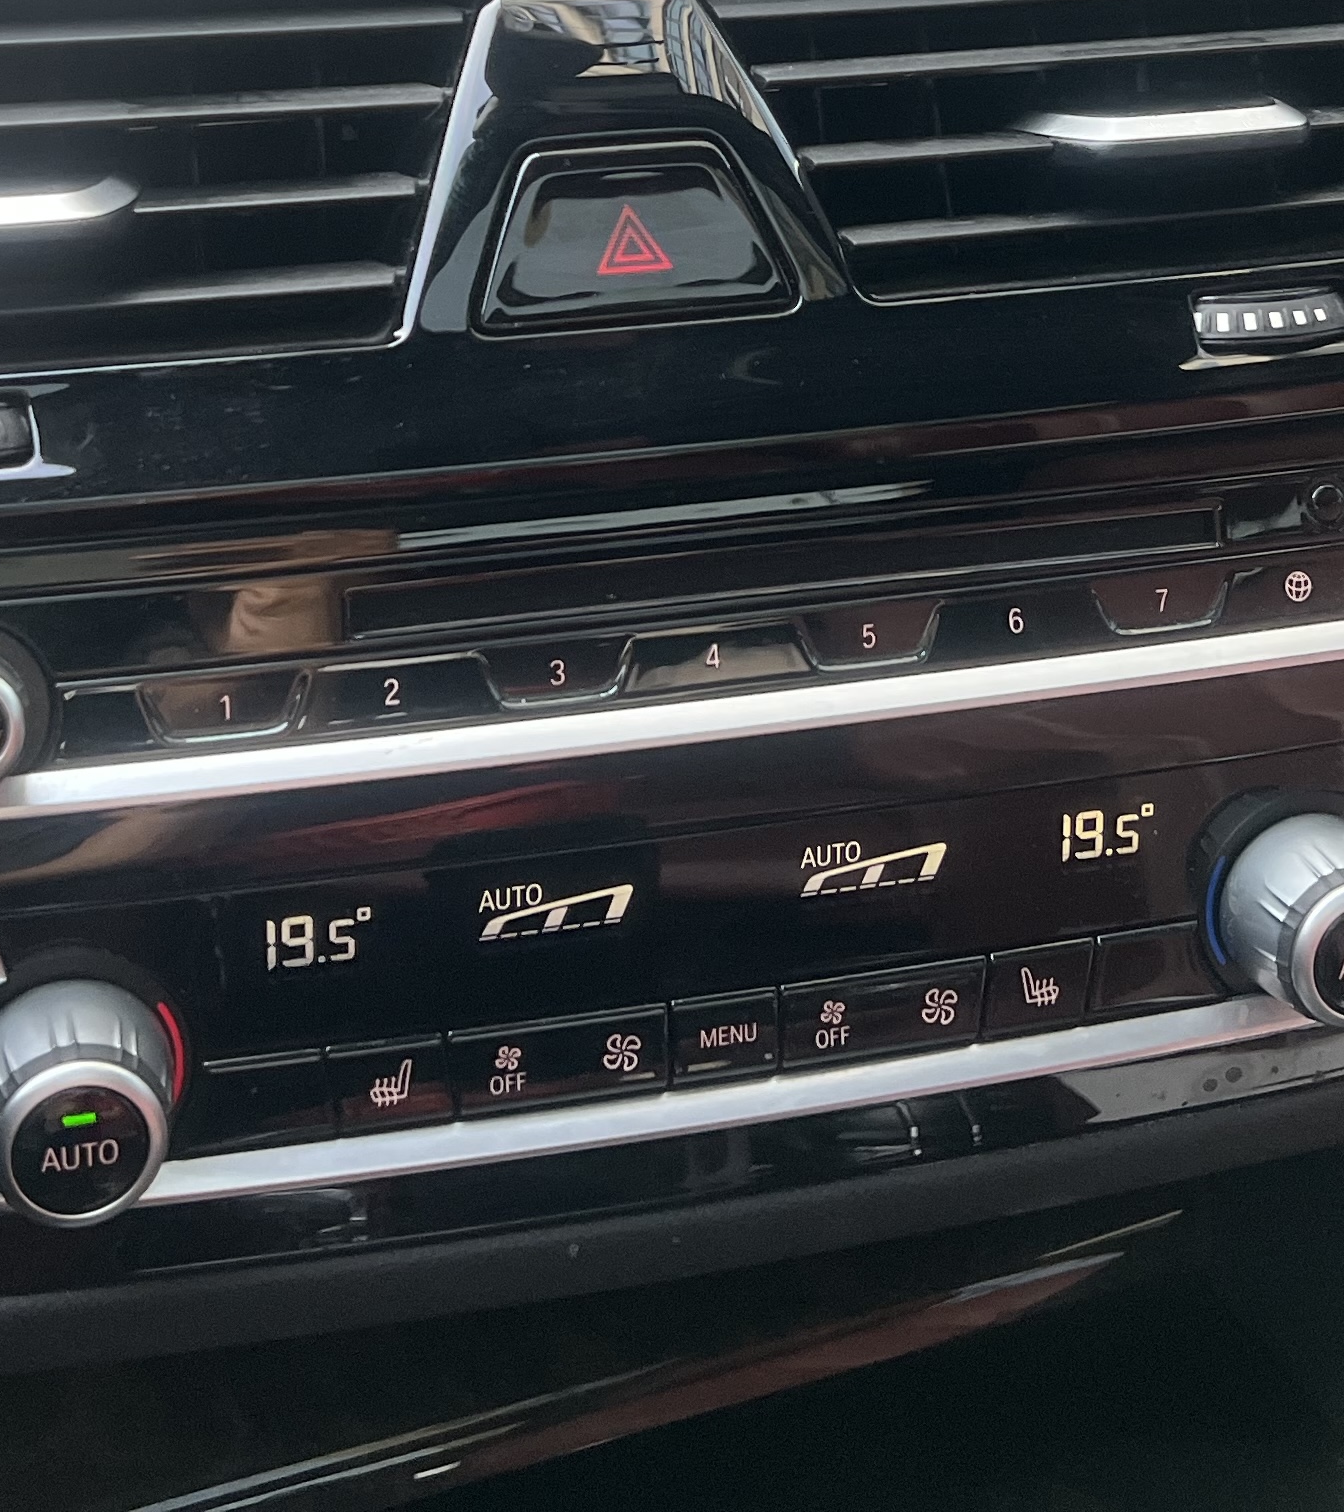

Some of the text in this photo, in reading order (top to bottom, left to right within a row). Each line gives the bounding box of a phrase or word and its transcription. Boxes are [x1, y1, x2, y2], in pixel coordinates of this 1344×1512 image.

[1154, 588, 1169, 613] 7
[1007, 606, 1025, 635] 6
[861, 621, 877, 650] 5
[704, 642, 721, 669] 4
[548, 660, 566, 686] 3
[383, 678, 400, 706] 2
[218, 694, 232, 721] 1
[799, 840, 862, 870] AUTO
[478, 883, 544, 914] AUTO
[699, 1022, 758, 1049] MENU
[814, 1025, 851, 1050] OFF
[489, 1071, 528, 1096] OFF
[40, 1138, 120, 1174] AUTO
